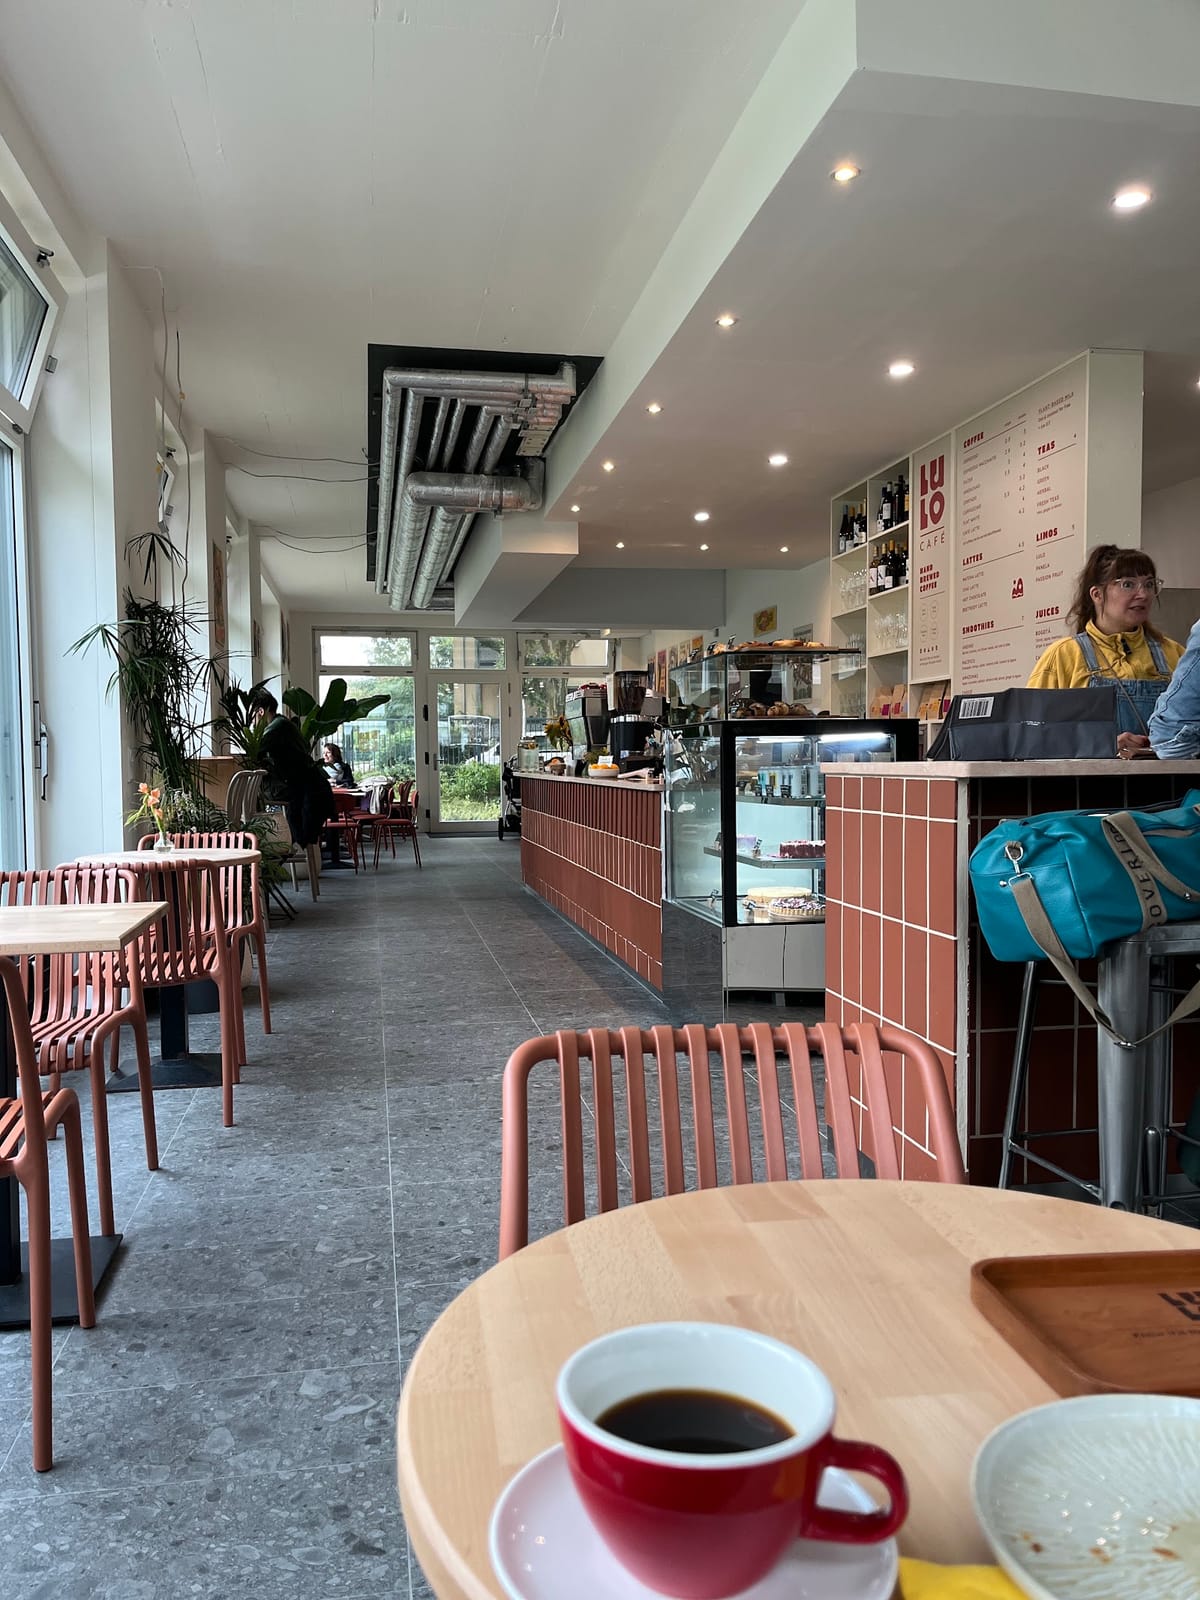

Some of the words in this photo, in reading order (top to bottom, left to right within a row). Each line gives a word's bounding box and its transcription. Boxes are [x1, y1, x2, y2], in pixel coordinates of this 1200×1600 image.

[963, 431, 984, 448] COFFEE
[1038, 440, 1055, 455] TEAS
[919, 530, 945, 552] CAFÉ
[962, 552, 983, 566] LATTES
[919, 563, 933, 574] HAND
[919, 570, 940, 584] BREWED
[919, 581, 937, 593] COFFEE
[1036, 606, 1060, 618] JUICES
[962, 620, 995, 635] SMOOTHIES
